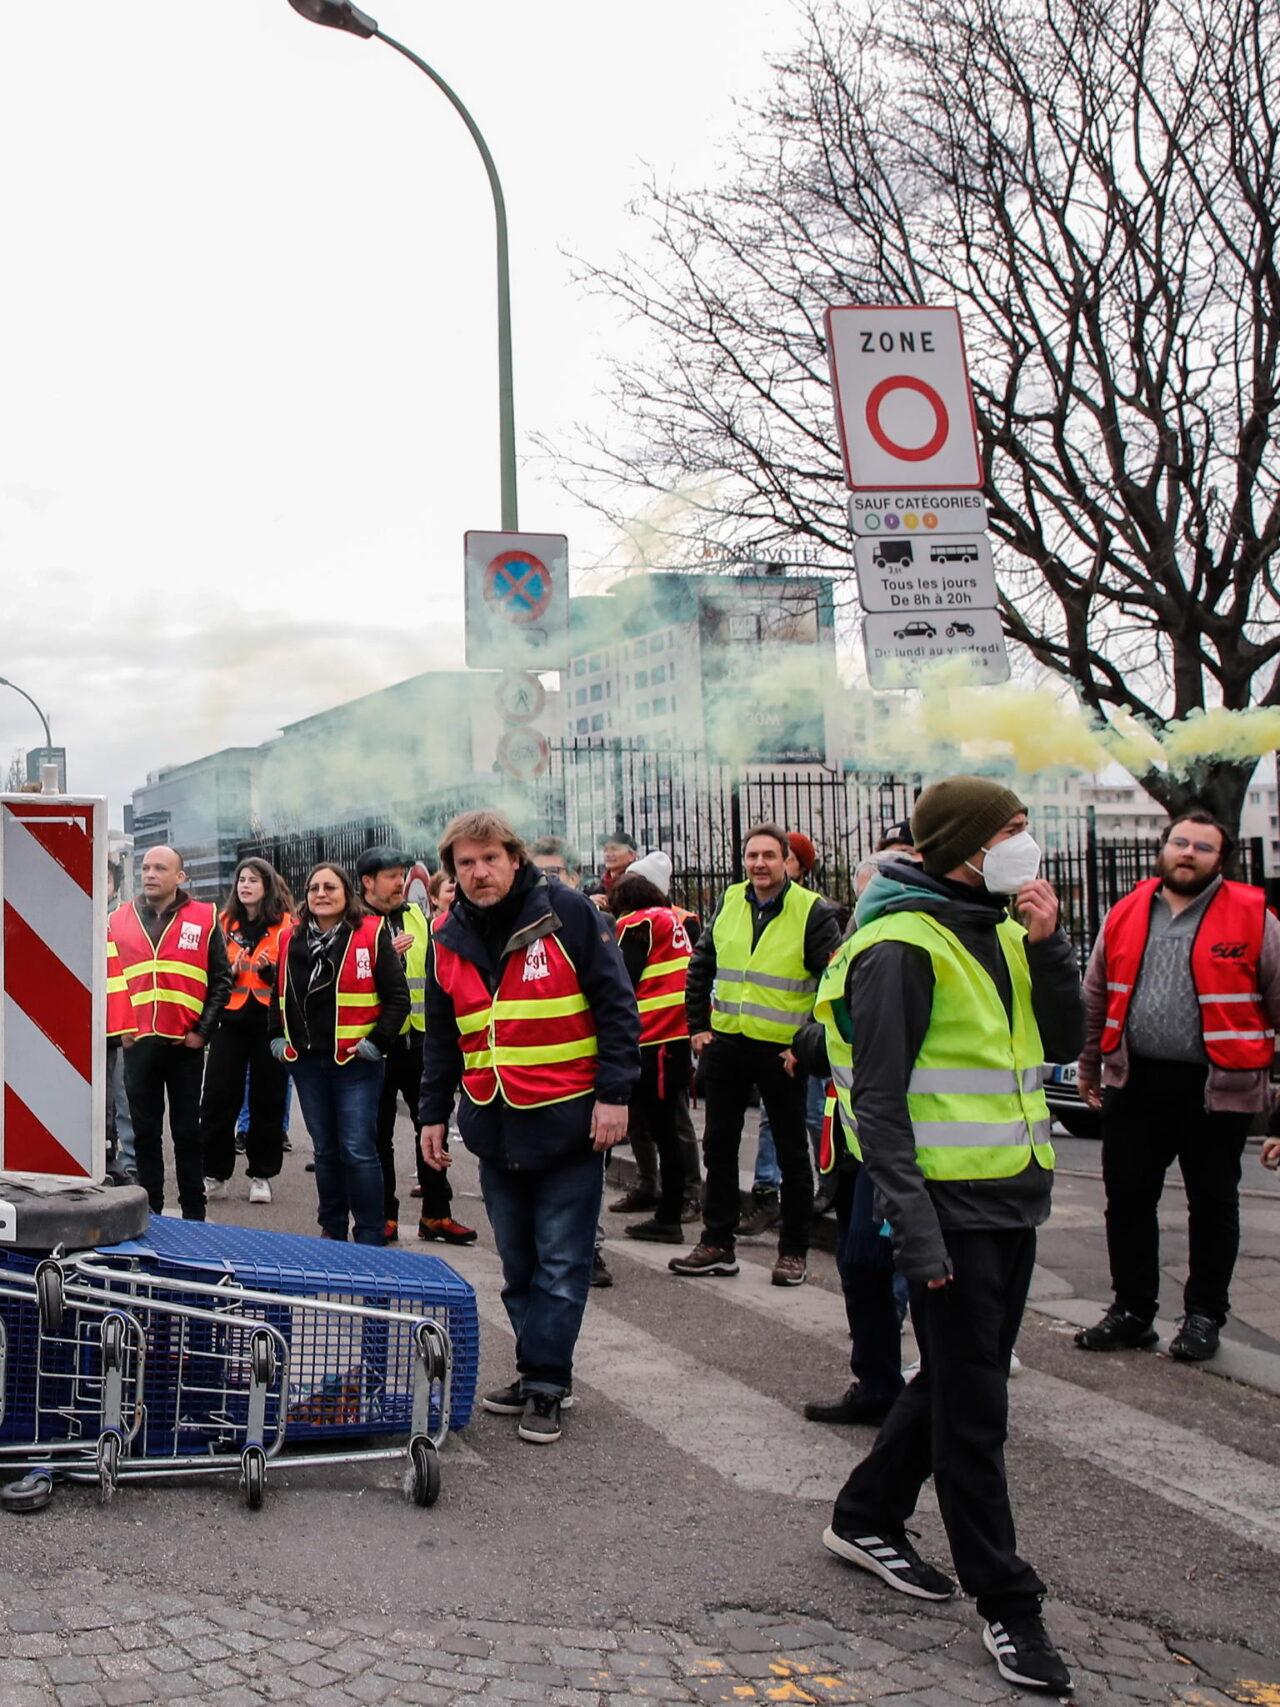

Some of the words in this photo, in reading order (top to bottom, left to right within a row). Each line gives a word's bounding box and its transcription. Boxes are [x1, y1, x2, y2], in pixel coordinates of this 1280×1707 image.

[859, 331, 935, 352] ZONE
[855, 498, 891, 510] SAUF
[895, 494, 981, 509] CATÉGORIES
[740, 548, 824, 562] NOVOTEL
[881, 579, 913, 591] Tous
[918, 578, 938, 589] les
[942, 577, 977, 591] jours
[891, 595, 910, 606] De
[914, 594, 930, 605] 8h
[935, 593, 943, 604] à
[947, 592, 972, 604] 20h
[895, 646, 925, 657] lundi
[181, 932, 201, 944] cgt
[526, 952, 547, 970] cgt
[1063, 1068, 1078, 1081] AP
